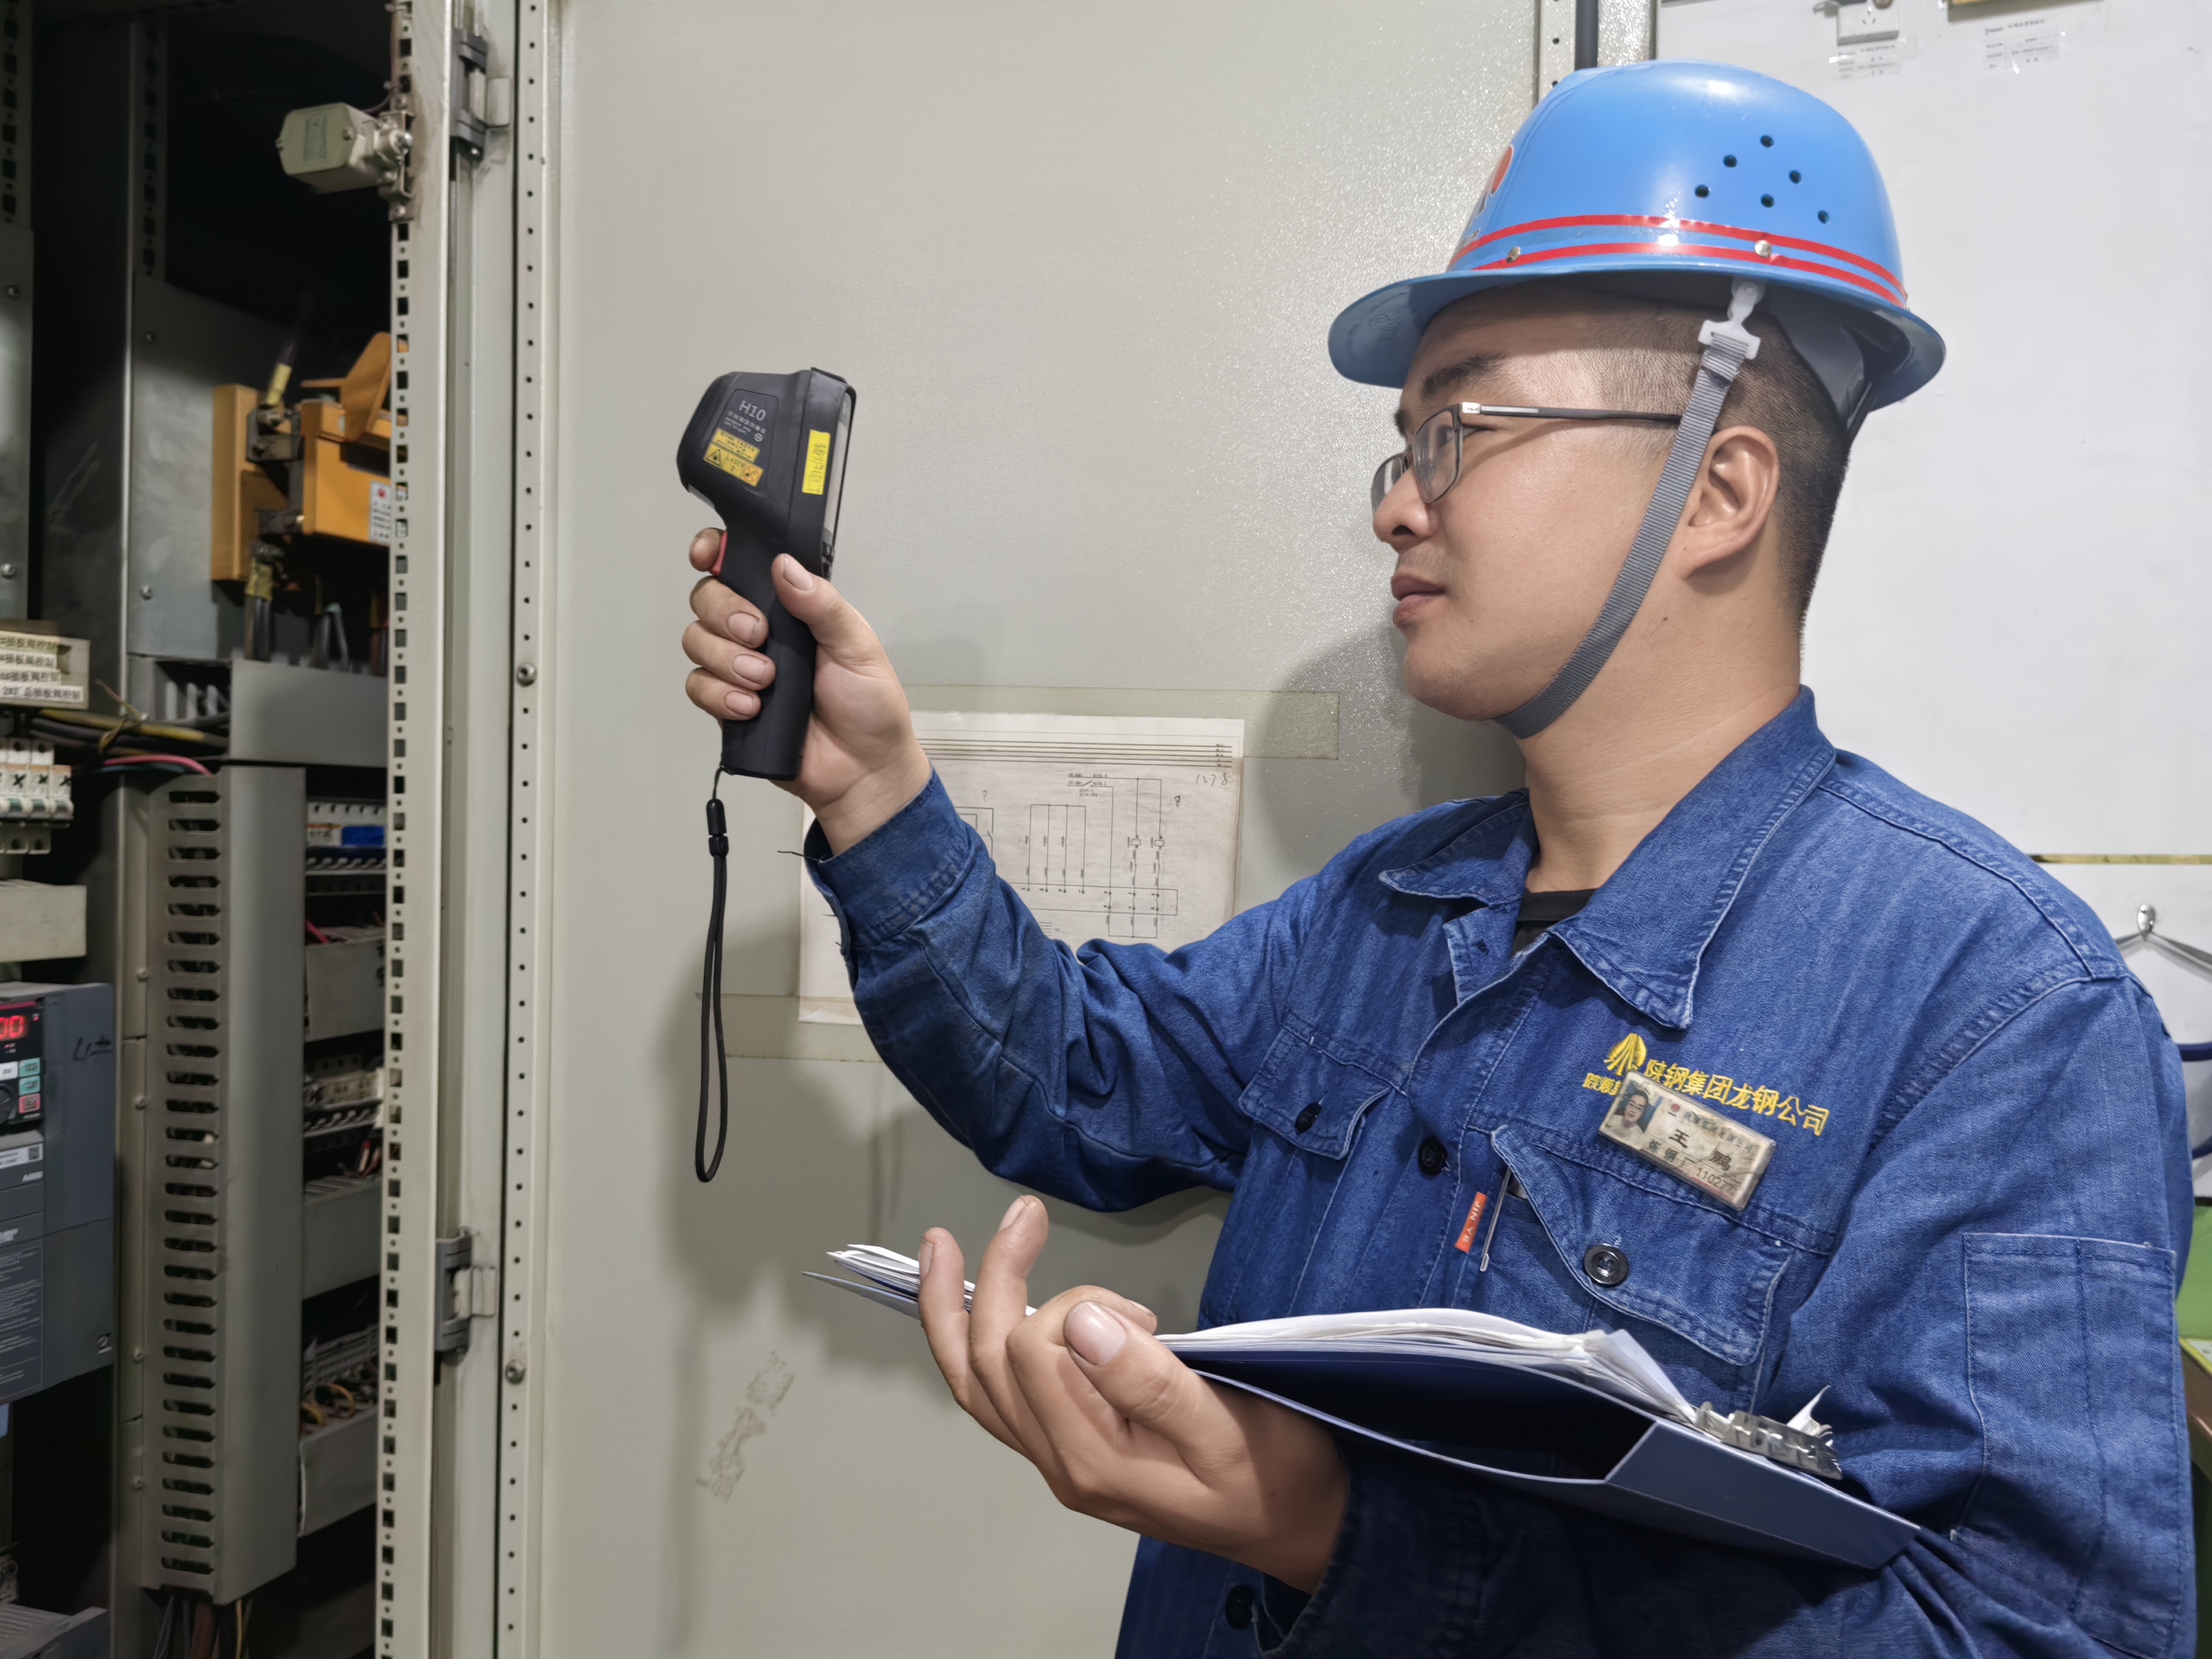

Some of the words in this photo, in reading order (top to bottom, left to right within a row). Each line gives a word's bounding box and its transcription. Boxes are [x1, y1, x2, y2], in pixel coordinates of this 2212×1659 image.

[739, 400, 766, 421] H10
[1644, 1059, 1830, 1136] 陕钢集团龙钢公司
[1669, 1129, 1690, 1149] 王
